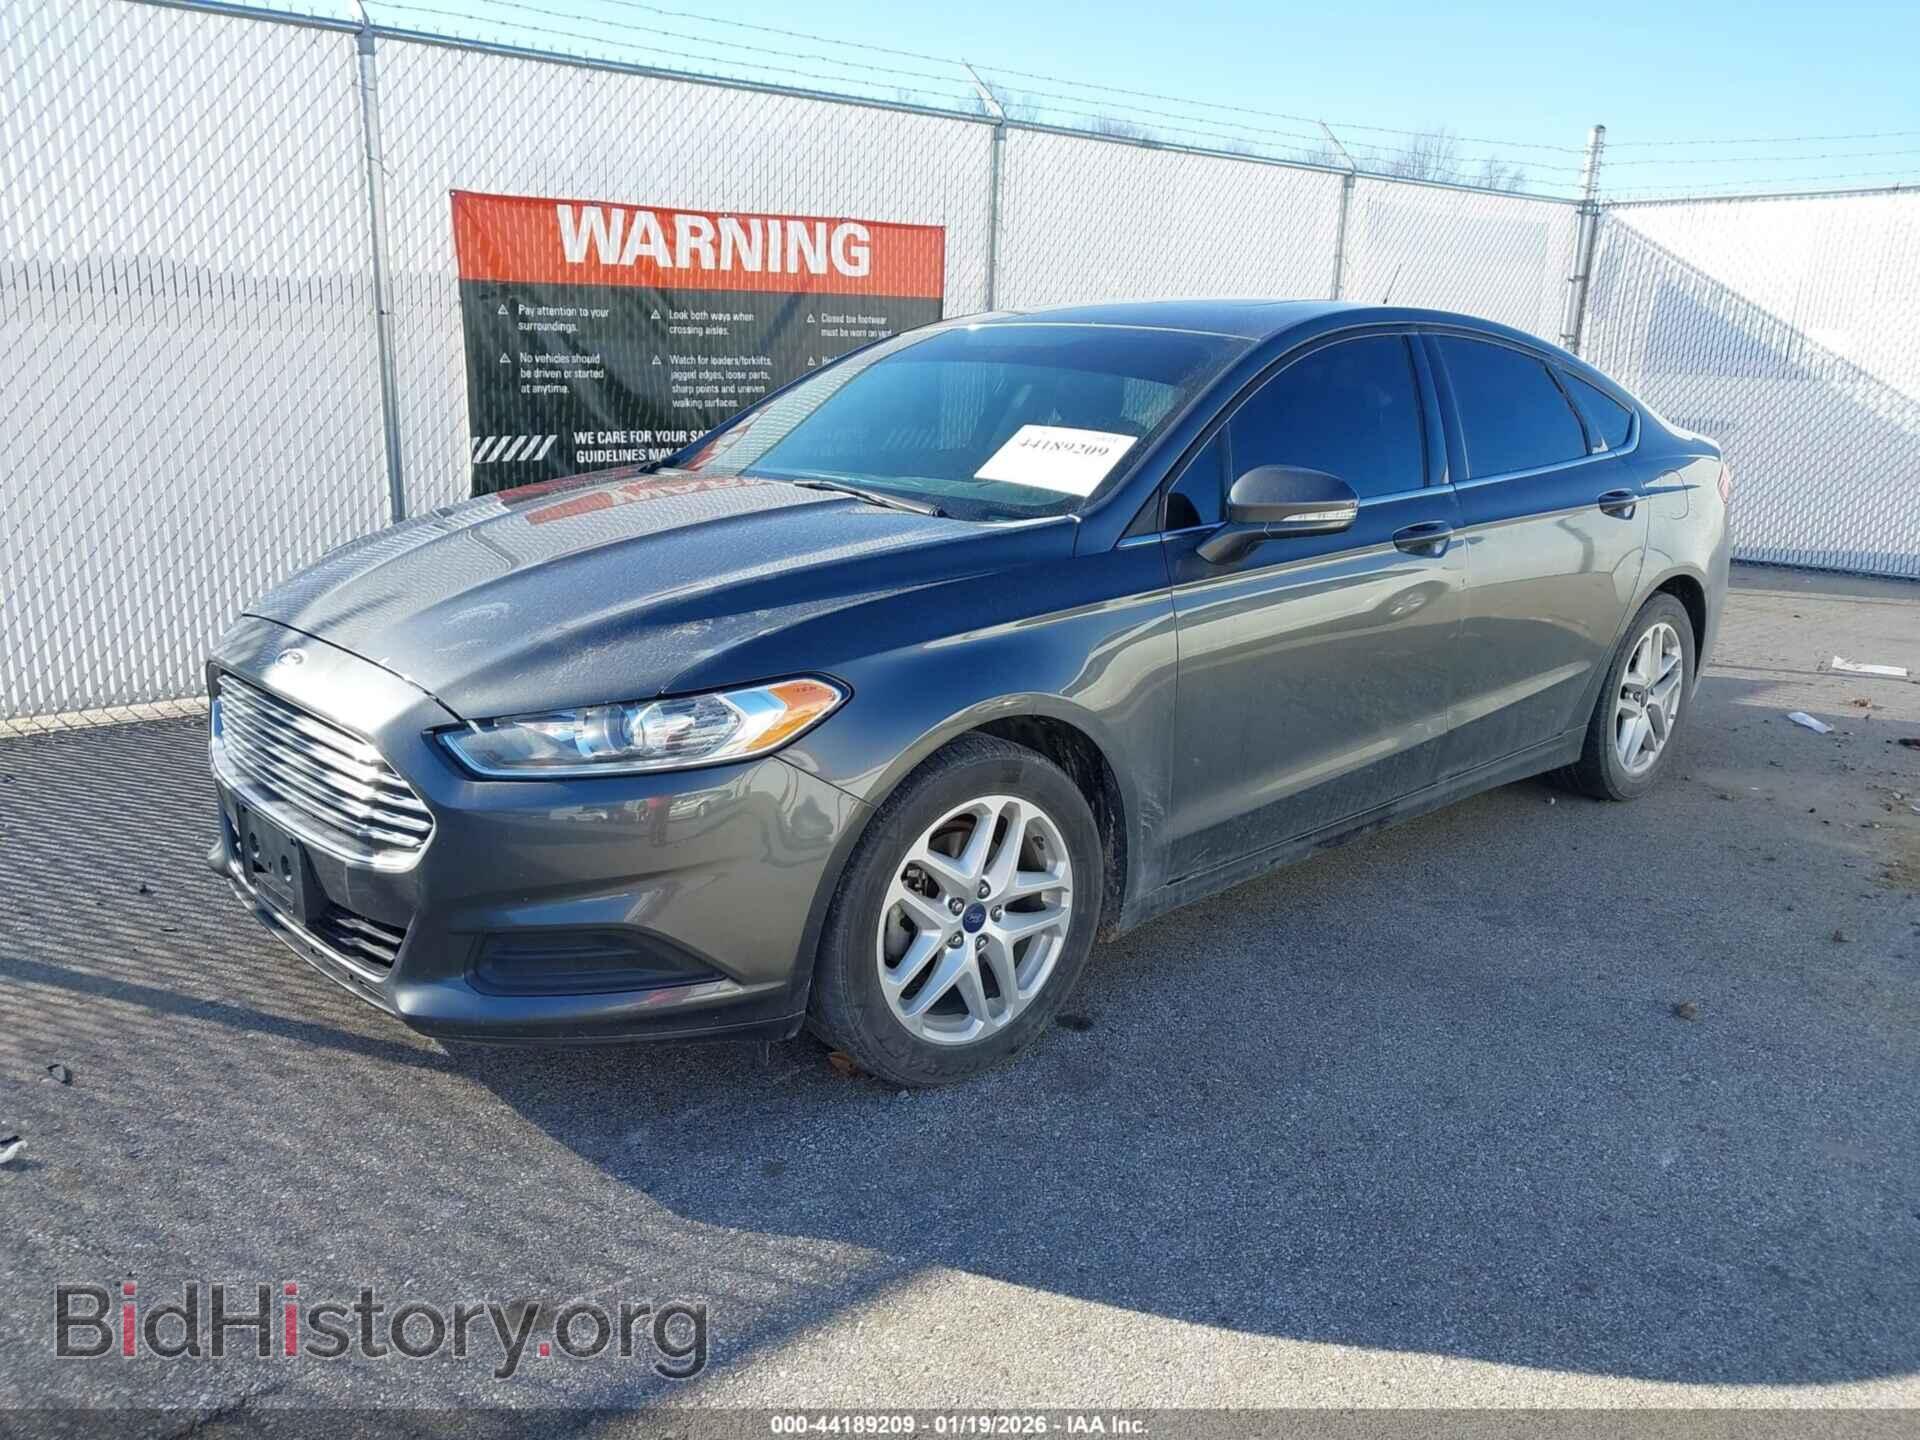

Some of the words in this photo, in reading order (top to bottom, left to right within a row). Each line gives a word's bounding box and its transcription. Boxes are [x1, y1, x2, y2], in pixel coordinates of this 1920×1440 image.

[556, 204, 871, 277] WARNING
[518, 304, 535, 317] Pay
[537, 305, 577, 316] attention
[579, 305, 589, 317] to
[590, 309, 609, 319] your
[669, 309, 689, 320] Look
[690, 309, 709, 320] both
[710, 312, 731, 323] ways
[733, 312, 754, 321] when
[518, 321, 579, 334] surroundings.
[669, 326, 703, 336] crossing
[705, 325, 730, 336] aisles.
[821, 328, 839, 337] must
[840, 327, 849, 337] be
[520, 352, 533, 363] No
[535, 352, 570, 363] vehicles
[571, 353, 600, 364] should
[669, 354, 696, 365] Watch
[697, 354, 709, 365] for
[520, 368, 532, 378] be
[534, 368, 561, 378] driven
[563, 370, 572, 378] or
[574, 368, 605, 378] started
[671, 370, 697, 382] jagged
[698, 369, 724, 382] edges,
[725, 370, 746, 380] loose
[748, 371, 771, 382] parts,
[521, 384, 530, 393] at
[532, 383, 570, 395] anytime.
[672, 384, 694, 395] sharp
[695, 384, 719, 395] points
[721, 384, 735, 394] and
[737, 386, 765, 394] uneven
[672, 398, 702, 410] walking
[704, 397, 738, 408] surfaces.
[573, 431, 595, 445] WE
[597, 431, 627, 444] CARE
[630, 430, 651, 443] FOR
[656, 430, 687, 442] YOUR
[1019, 436, 1109, 457] 44189209
[576, 449, 646, 463] GUIDELINES
[648, 447, 674, 462] MAY
